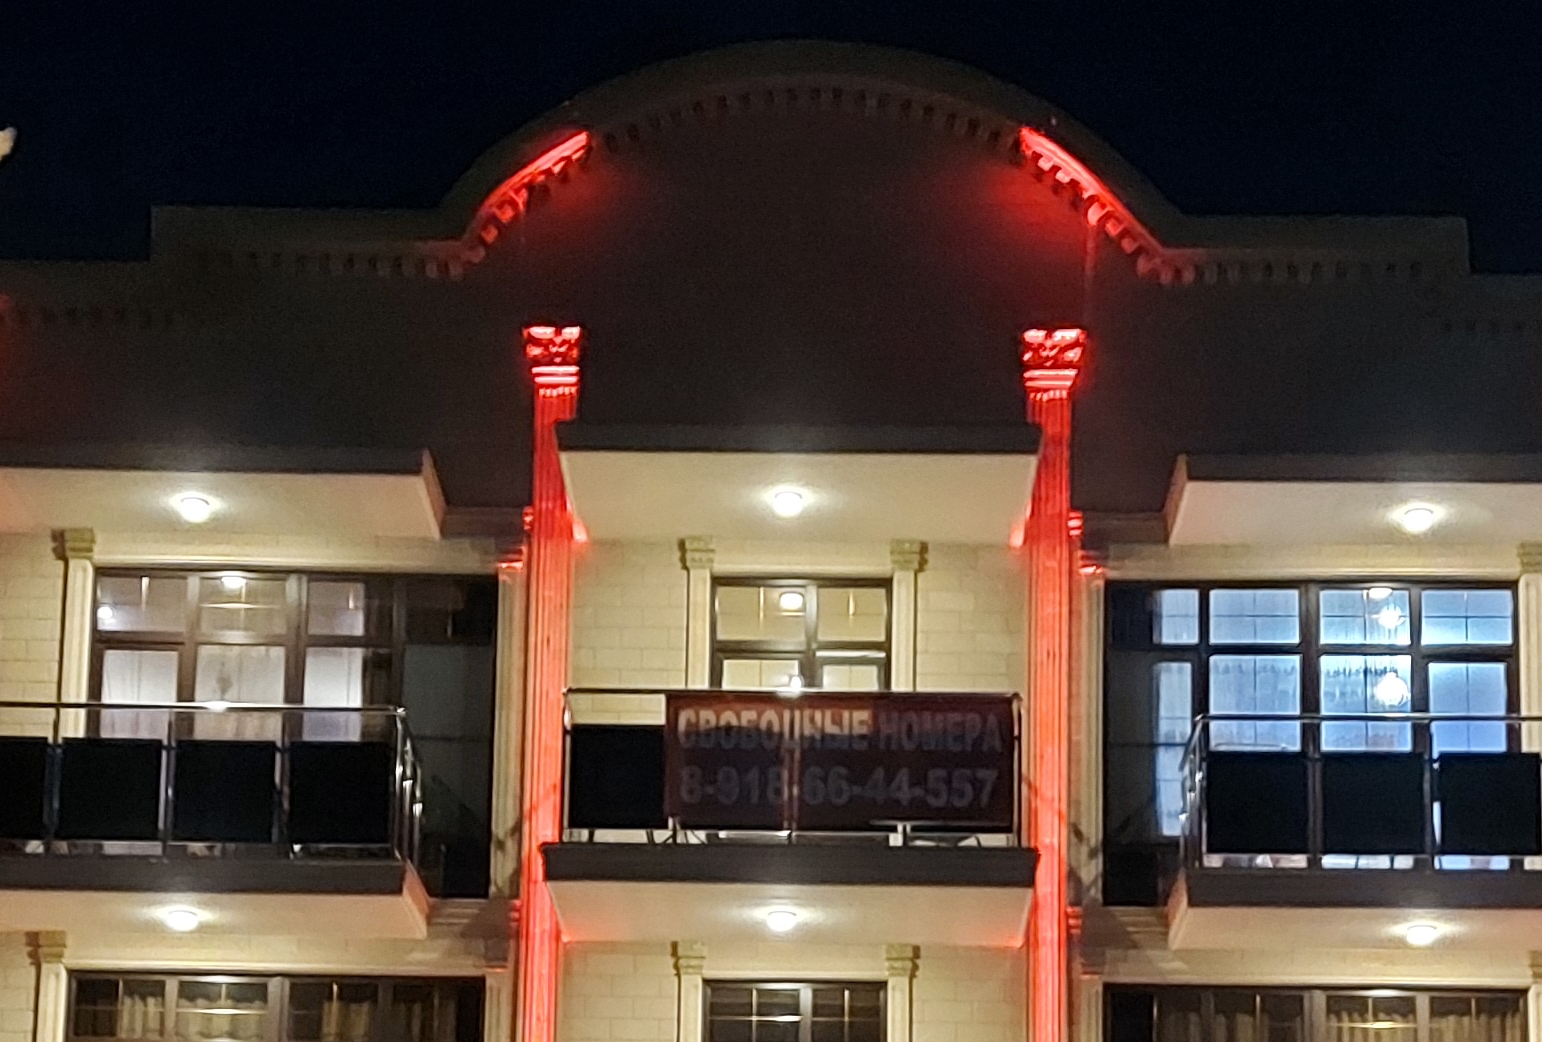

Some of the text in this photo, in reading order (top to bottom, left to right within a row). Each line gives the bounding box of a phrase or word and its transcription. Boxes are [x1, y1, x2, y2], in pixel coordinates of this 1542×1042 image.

[677, 707, 1003, 753] СВОБОДНЫЕ НОМЕРА
[679, 764, 999, 809] 8-91866-44-557
